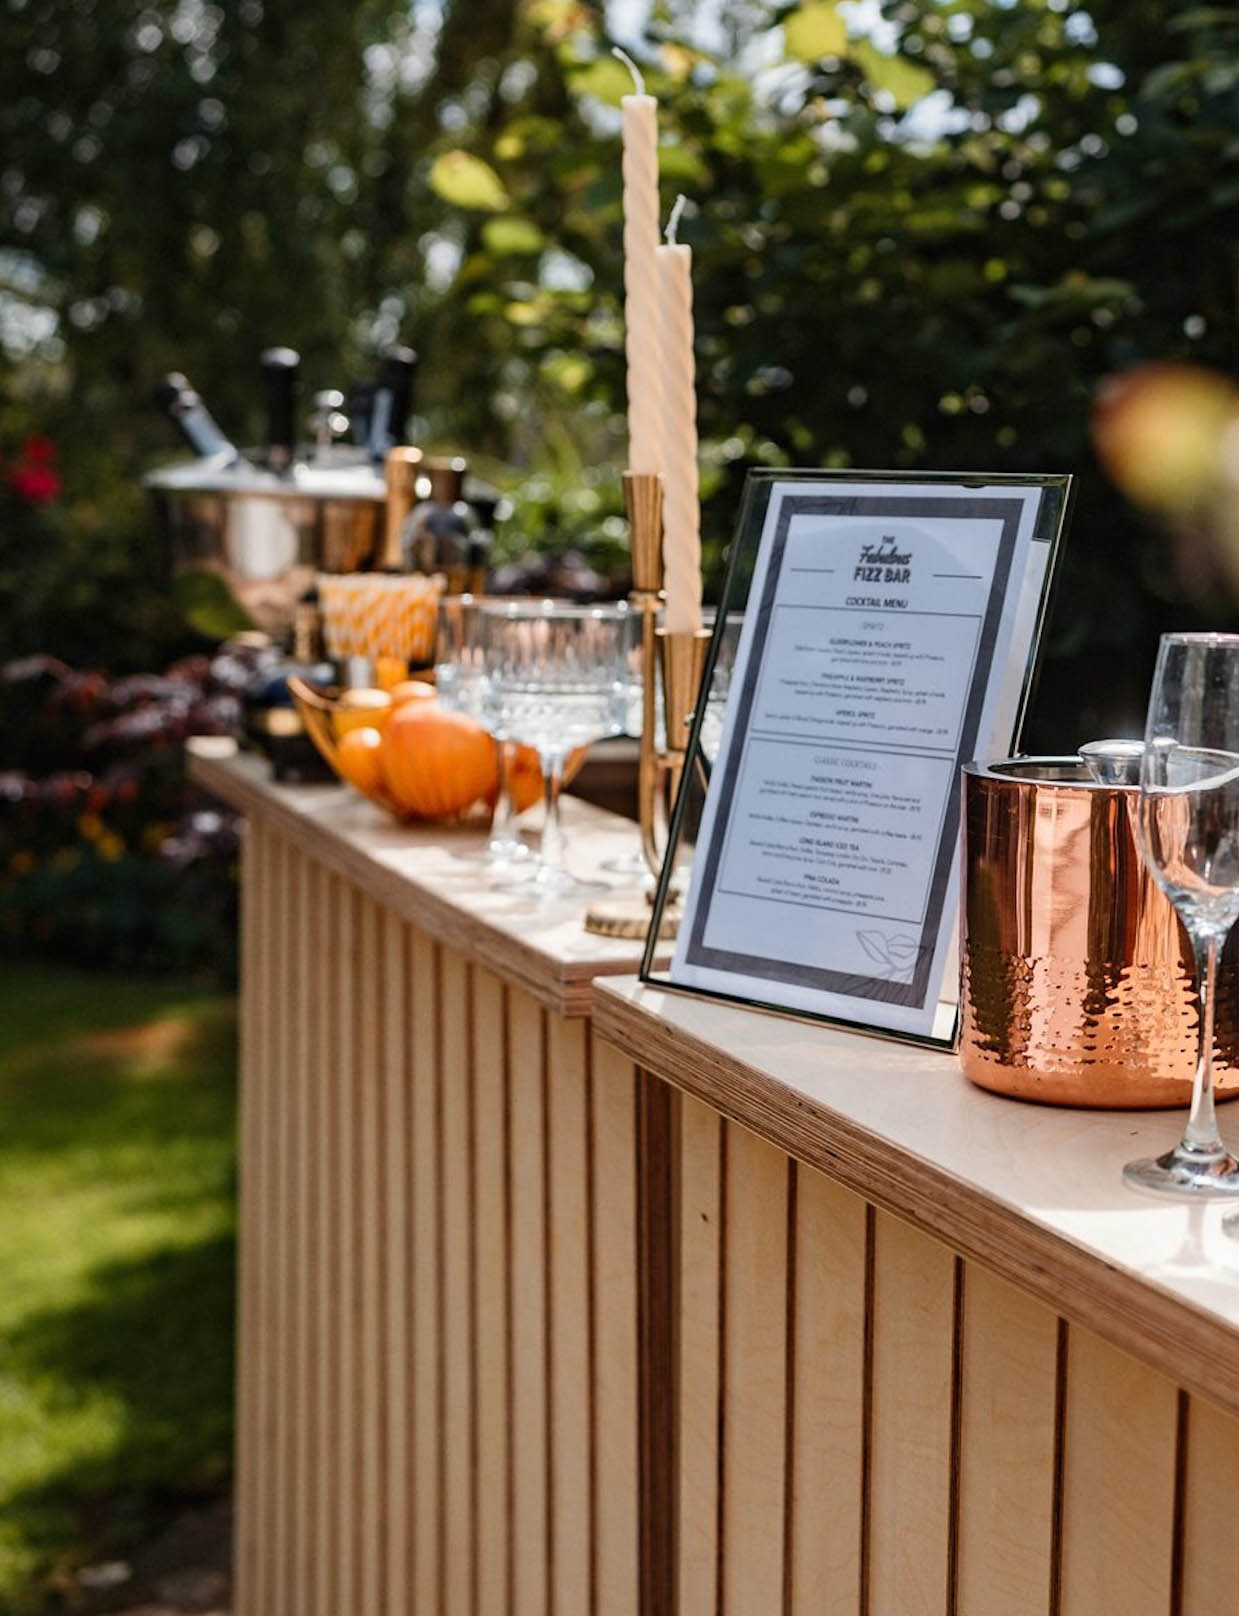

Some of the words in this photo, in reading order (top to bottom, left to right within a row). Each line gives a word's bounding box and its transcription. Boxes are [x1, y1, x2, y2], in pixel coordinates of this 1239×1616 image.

[858, 544, 912, 565] Fabulous
[854, 566, 883, 582] FIZZ
[884, 567, 911, 584] BAR
[845, 596, 881, 608] COCKTAIL
[883, 597, 908, 609] MENU
